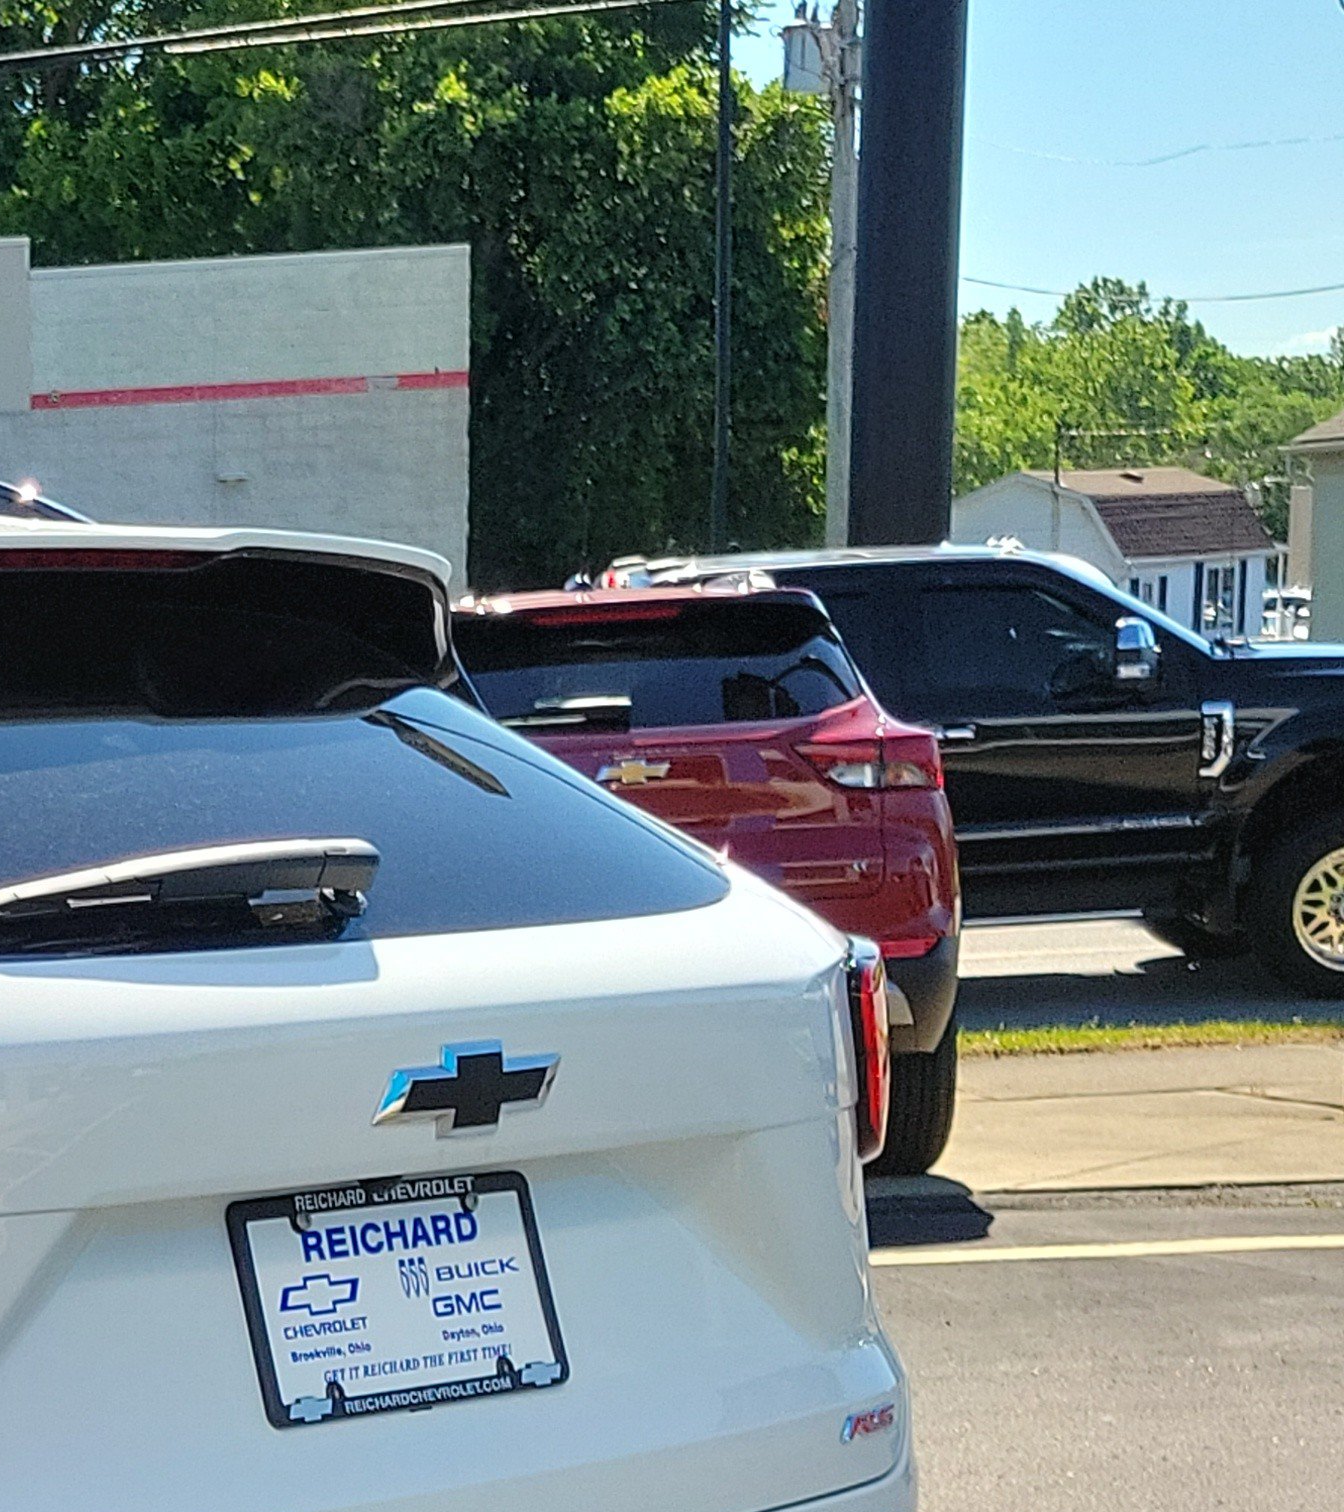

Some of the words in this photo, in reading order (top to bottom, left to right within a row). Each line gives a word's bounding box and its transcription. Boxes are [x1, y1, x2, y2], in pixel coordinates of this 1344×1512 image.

[295, 1189, 366, 1211] REICHARD
[302, 1212, 478, 1263] REICHARD
[435, 1257, 520, 1282] BUICK
[432, 1288, 503, 1318] GMC
[283, 1316, 368, 1340] CHEVROLET
[442, 1328, 481, 1342] Dayton,
[481, 1321, 505, 1336] Ohio
[290, 1346, 347, 1364] Brookville,
[347, 1341, 372, 1355] Ohio
[324, 1369, 346, 1384] GET
[348, 1366, 360, 1381] IT
[363, 1358, 421, 1379] REICHARD
[422, 1353, 445, 1370] THE
[448, 1348, 479, 1367] FIRST
[344, 1379, 512, 1415] REICHARDCHEVROLET.COM
